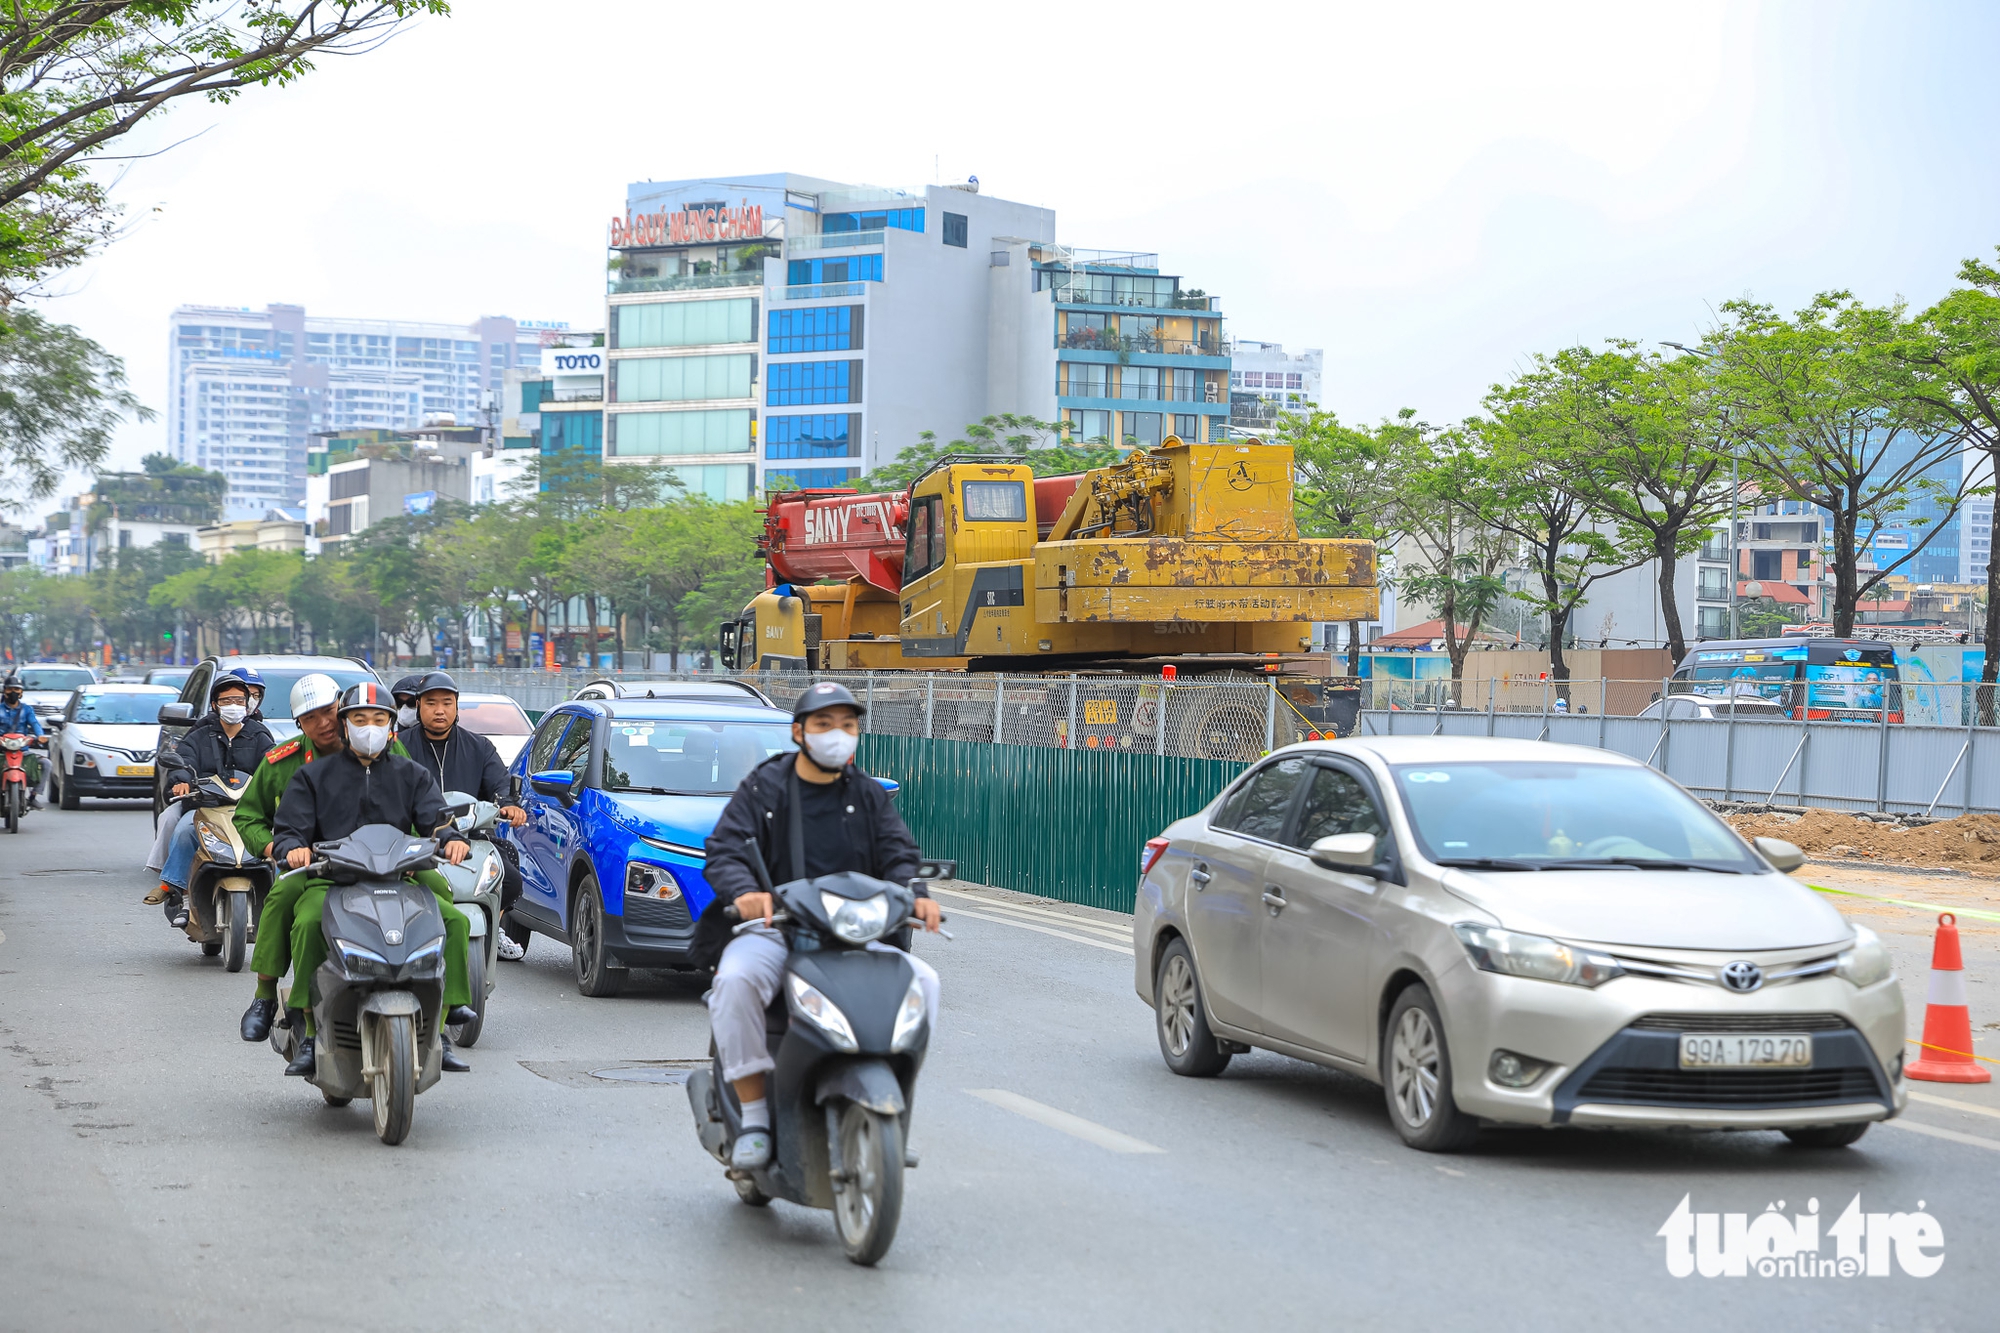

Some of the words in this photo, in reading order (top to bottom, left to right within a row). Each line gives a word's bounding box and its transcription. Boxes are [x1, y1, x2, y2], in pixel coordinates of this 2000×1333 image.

[611, 208, 632, 246] ĐÁ
[634, 204, 668, 245] QUÝ
[555, 354, 600, 370] TOTO
[804, 504, 852, 545] SANY
[1153, 621, 1210, 634] SANY
[1818, 672, 1835, 681] TOP
